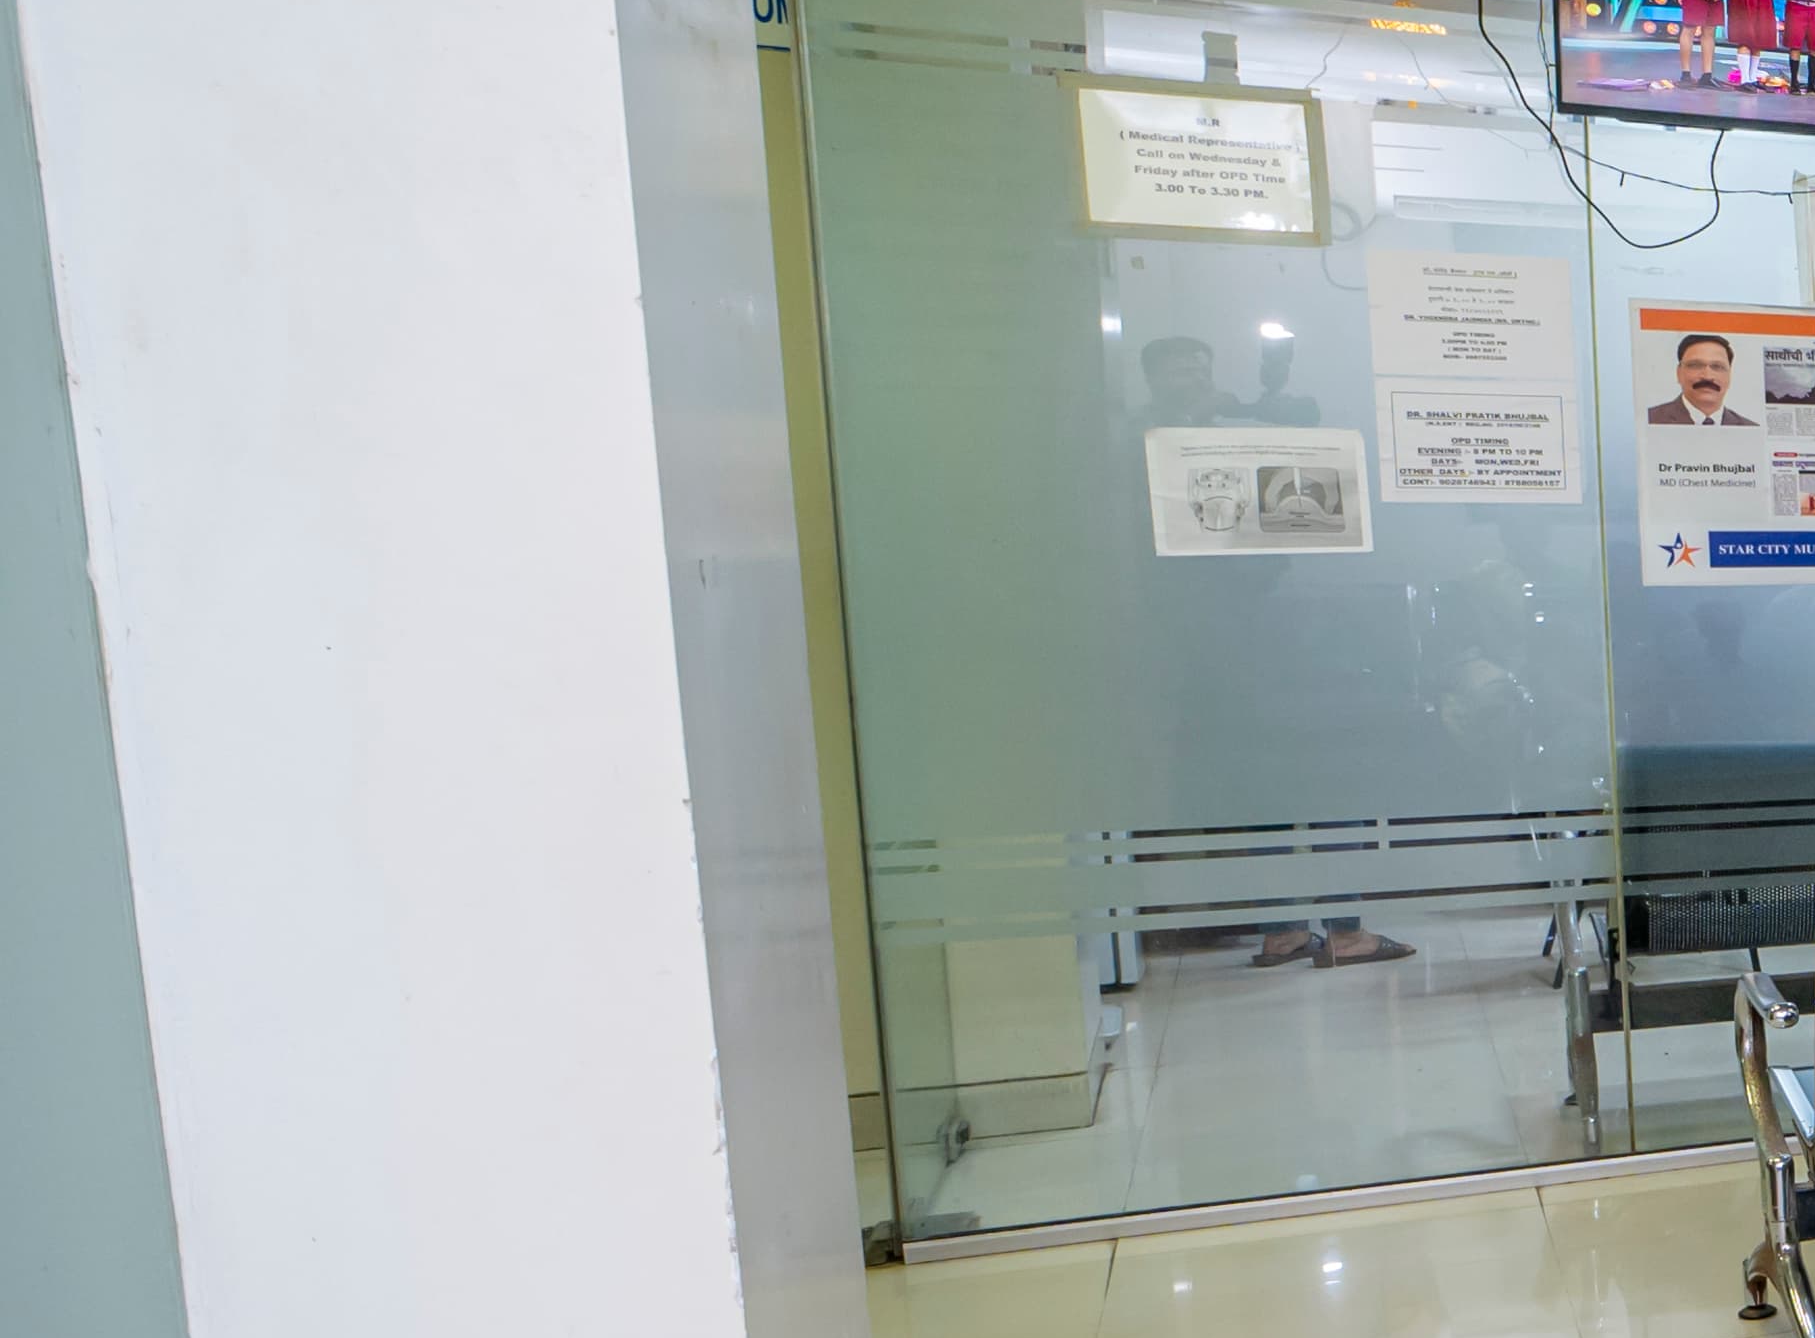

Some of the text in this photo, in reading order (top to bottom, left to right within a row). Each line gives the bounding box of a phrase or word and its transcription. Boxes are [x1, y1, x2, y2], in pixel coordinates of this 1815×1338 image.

[1128, 130, 1184, 143] Medical
[1136, 148, 1282, 168] Call on Wednesday &
[1134, 164, 1286, 184] Friday after OPD Time
[1155, 183, 1269, 200] 3.00 To 3.30 PM.
[1417, 447, 1462, 455] EVENING
[1493, 469, 1562, 477] APPOINTMENT
[1659, 463, 1755, 474] Dr Pravin Bhujbal
[1678, 479, 1708, 487] (Chest
[1711, 479, 1756, 487] Medicine)
[1718, 544, 1755, 555] STAR
[1758, 544, 1791, 555] CITY
